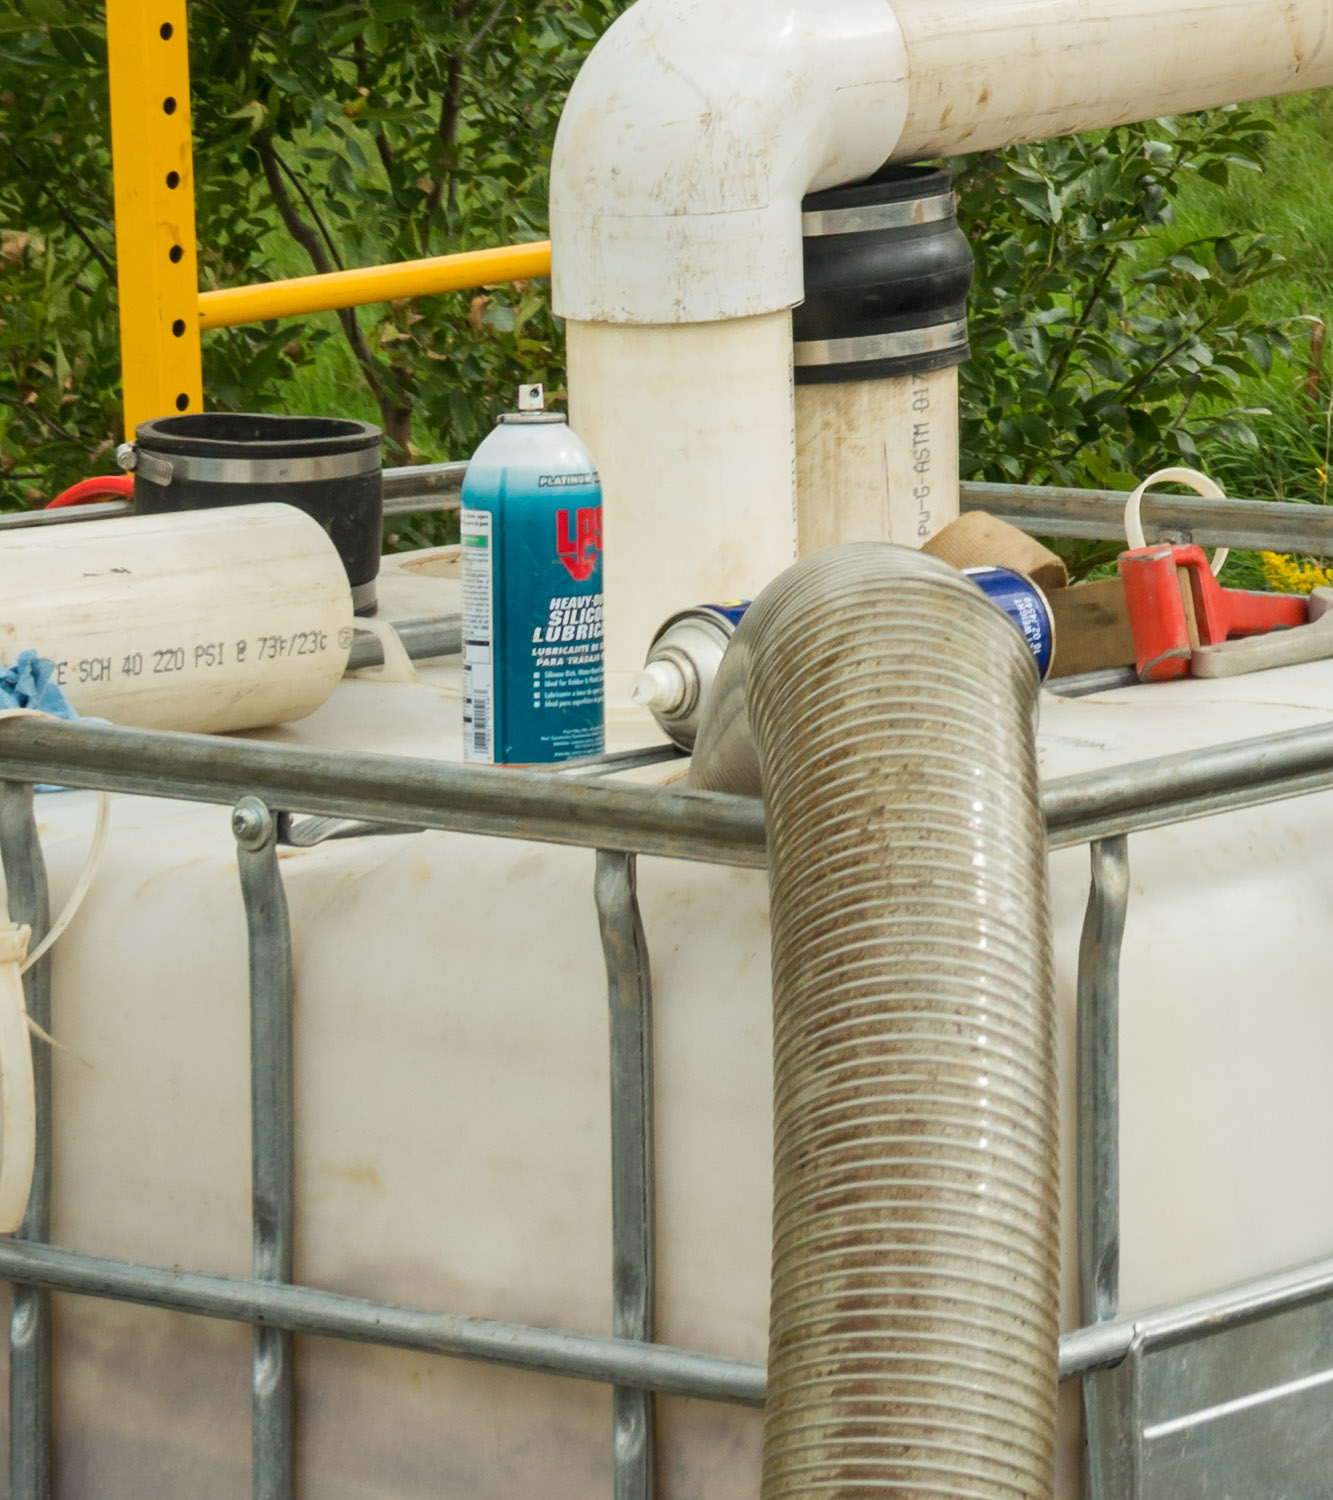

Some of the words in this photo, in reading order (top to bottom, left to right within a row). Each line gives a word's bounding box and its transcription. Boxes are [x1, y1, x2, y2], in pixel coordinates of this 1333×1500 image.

[538, 473, 591, 488] PLATINUM
[532, 644, 589, 656] LUBRICANTE
[78, 656, 111, 683] SCH
[122, 652, 143, 677] 40
[153, 647, 185, 673] 220
[194, 642, 224, 668] PSI
[536, 657, 564, 667] PARA
